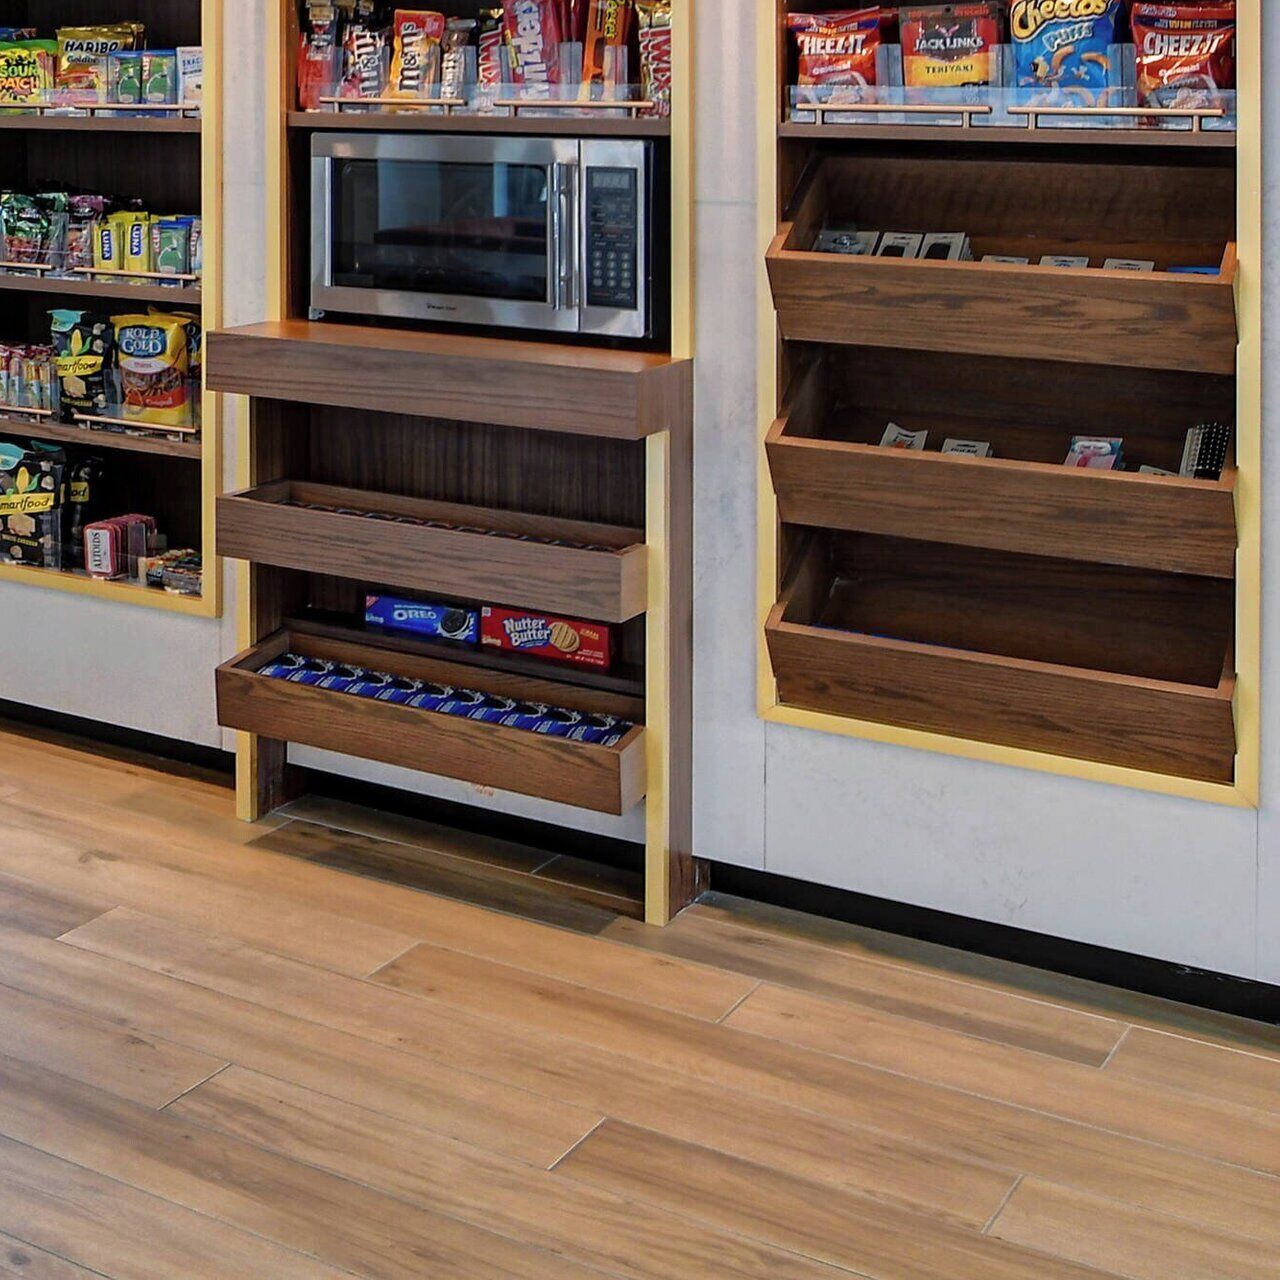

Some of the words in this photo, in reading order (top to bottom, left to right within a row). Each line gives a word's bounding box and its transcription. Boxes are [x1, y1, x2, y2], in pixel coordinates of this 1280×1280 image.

[64, 40, 119, 54] HARIBO
[914, 37, 945, 51] JACK
[1143, 31, 1225, 57] CHEEZ-IT
[924, 64, 974, 75] TERIYAKI
[102, 231, 112, 260] LUNA
[131, 225, 141, 255] LUNA
[125, 327, 161, 340] ROLD
[122, 339, 162, 354] GOLD
[54, 358, 97, 374] martfood
[92, 531, 103, 569] ALTOIDS
[393, 609, 438, 621] OREO
[503, 617, 546, 632] Nutter
[511, 626, 552, 647] Butter
